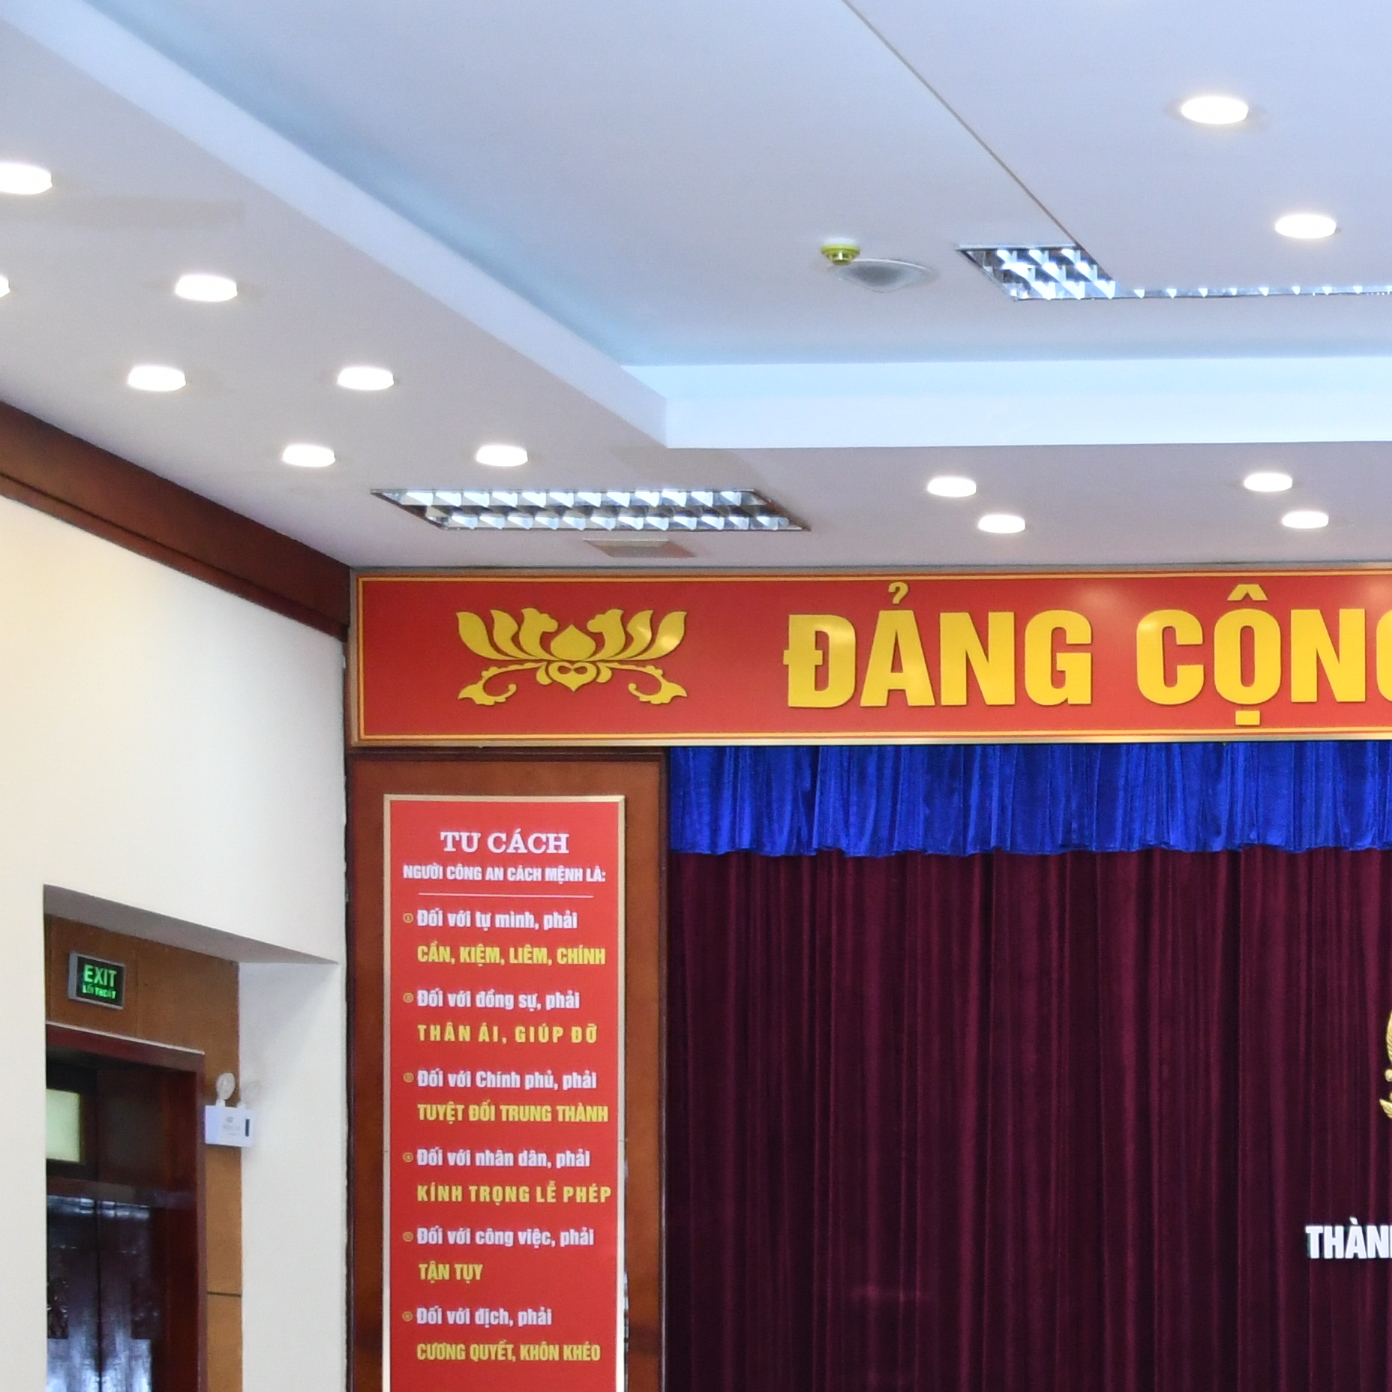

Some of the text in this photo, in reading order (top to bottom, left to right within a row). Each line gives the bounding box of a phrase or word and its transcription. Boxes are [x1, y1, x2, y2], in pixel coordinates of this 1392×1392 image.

[783, 582, 1092, 708] ĐẢNG
[440, 828, 569, 853] TƯ CÁCH
[403, 862, 605, 884] NGƯỜI CÔNG AN CÁCH MỆNH LÀ:
[417, 908, 577, 930] Đối với tự mình, phải
[417, 941, 605, 966] CẦN, KIỆM, LIÊM, CHÍNH
[83, 964, 117, 988] EXIT
[417, 988, 579, 1011] Đối với đồng sự, phải
[418, 1022, 597, 1043] THÂN ÁI, GIÚP ĐỠ
[417, 1068, 596, 1090] Đối với Chính phủ, phải
[418, 1099, 608, 1124] TUYỆT ĐỐI TRUNG THÀNH
[417, 1147, 589, 1168] Đối với nhân dân, phải
[417, 1180, 611, 1205] KÍNH TRỌNG LỄ PHÉP
[417, 1225, 593, 1248] Đối với công việc, phải
[419, 1260, 482, 1283] TẬN TỤY
[416, 1306, 551, 1327] Đối với địch, phải
[417, 1339, 600, 1361] CƯƠNG QUYẾT, KHÔN KHÉO
